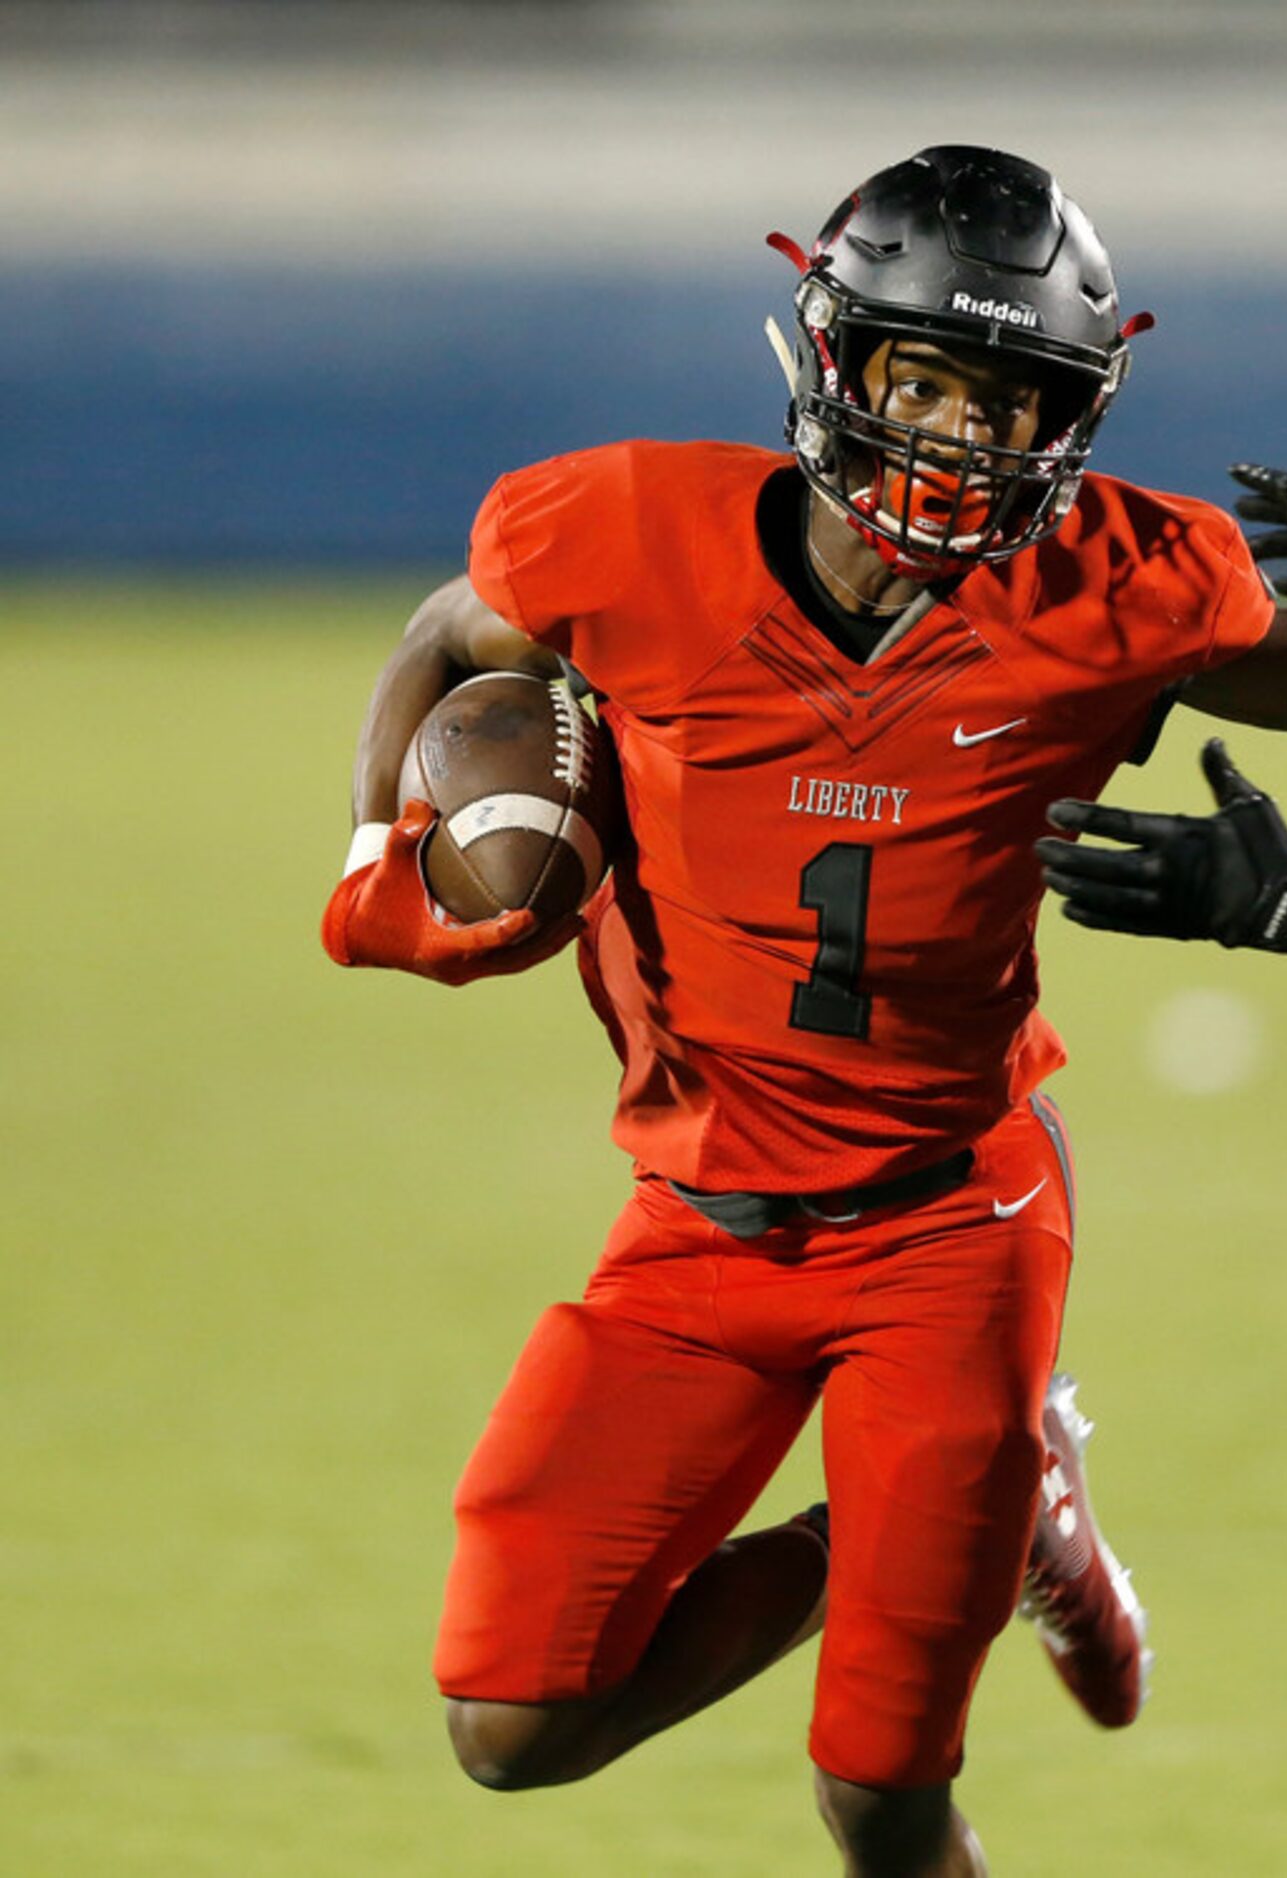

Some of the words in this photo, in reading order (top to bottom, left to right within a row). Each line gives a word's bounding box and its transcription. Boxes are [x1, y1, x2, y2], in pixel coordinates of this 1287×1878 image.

[952, 292, 1038, 328] Riddell
[787, 774, 911, 825] LIBERTY
[788, 841, 874, 1040] 1
